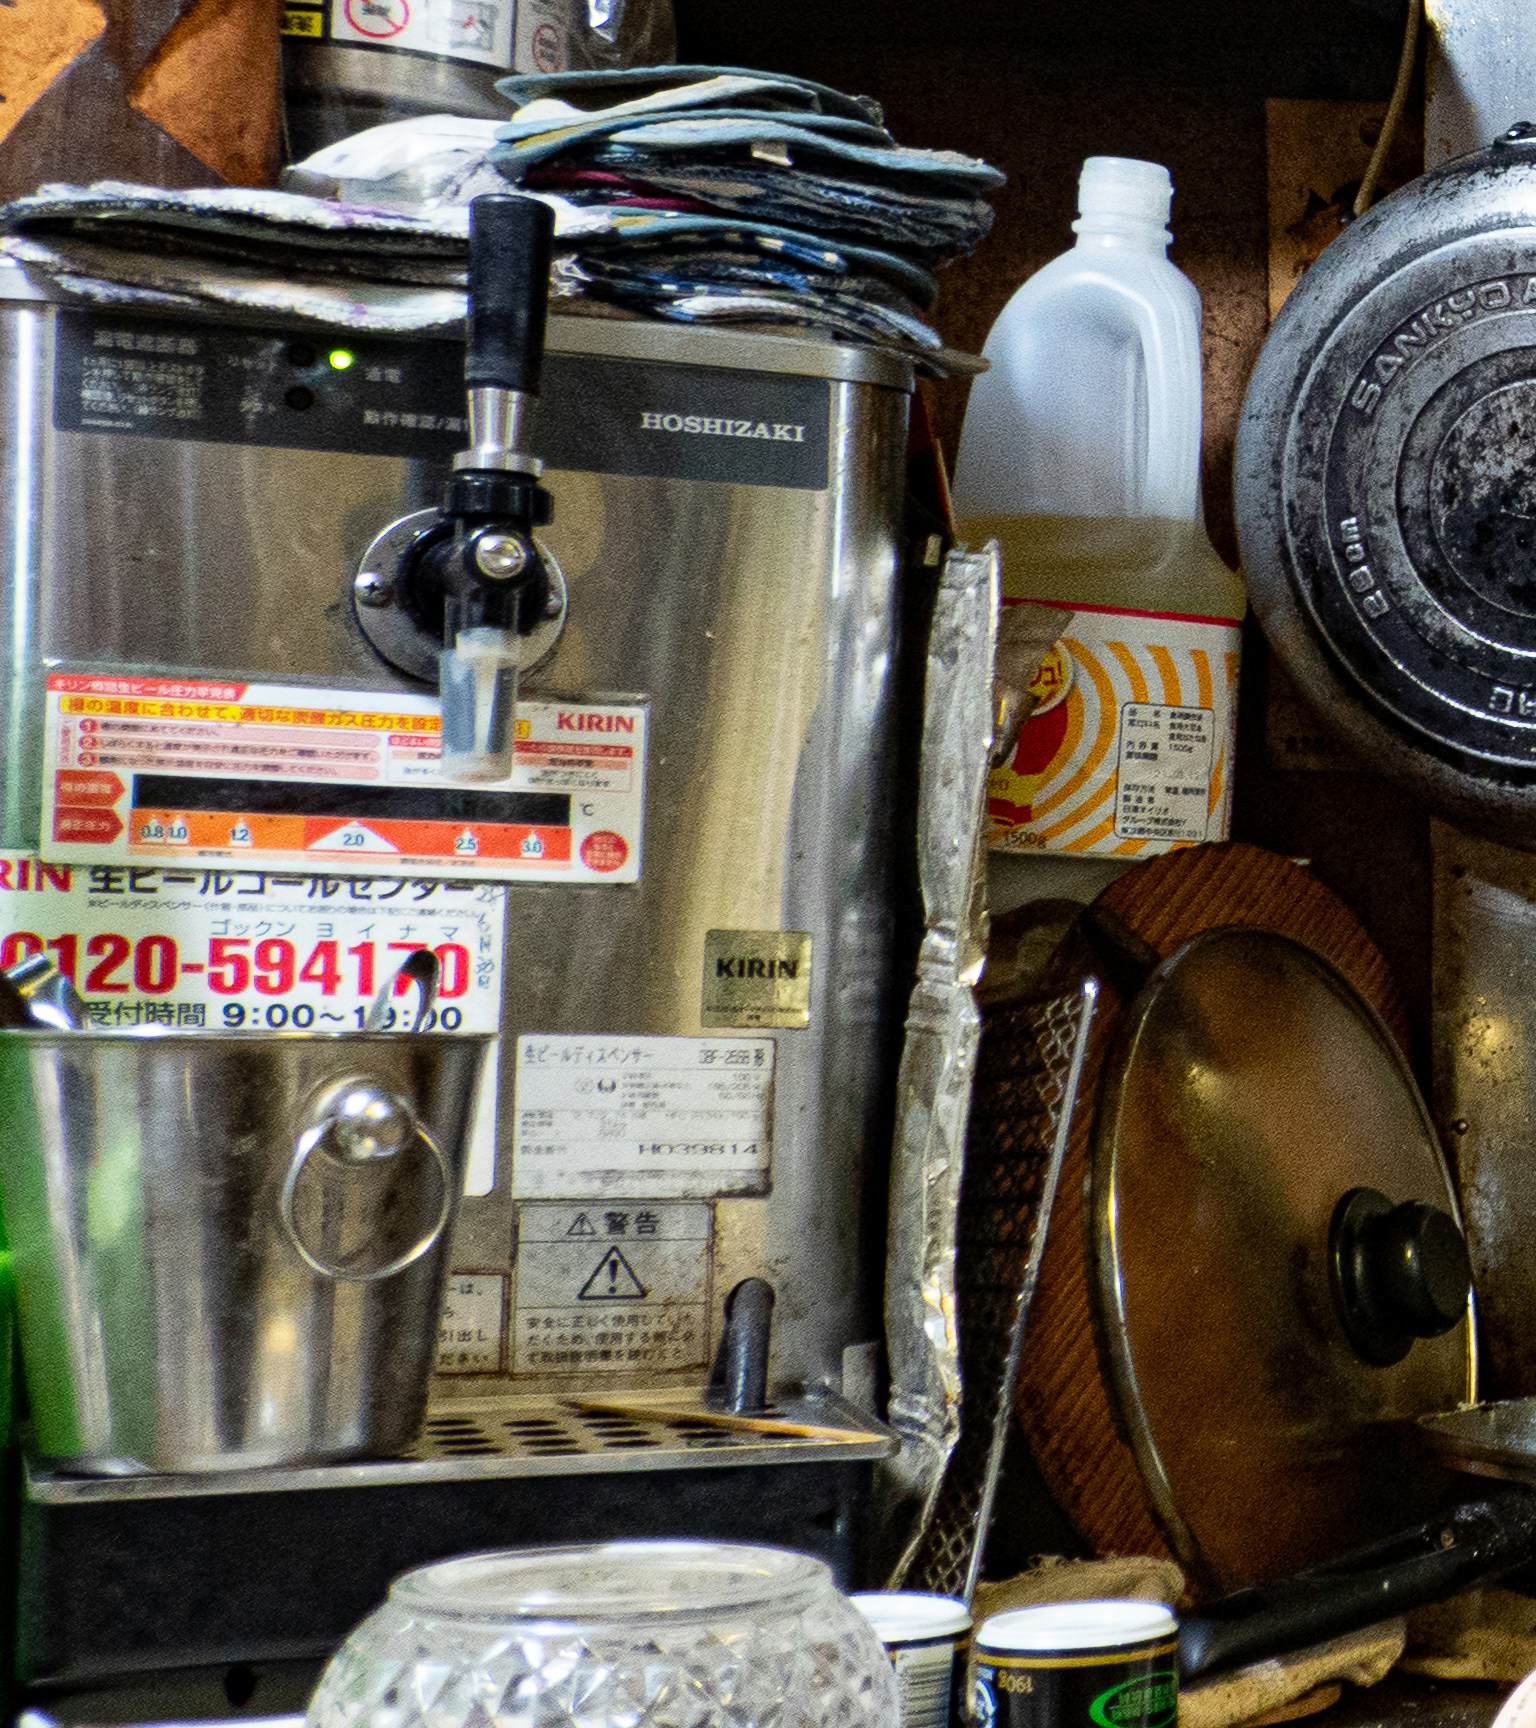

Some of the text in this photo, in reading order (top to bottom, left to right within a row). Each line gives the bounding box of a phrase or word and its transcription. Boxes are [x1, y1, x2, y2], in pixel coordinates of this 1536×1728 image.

[640, 410, 807, 444] HOSHIZAKI
[556, 710, 636, 735] KIRIN
[715, 957, 802, 981] KIRIN
[87, 1000, 208, 1029] 受付時間
[604, 1209, 659, 1236] 警告
